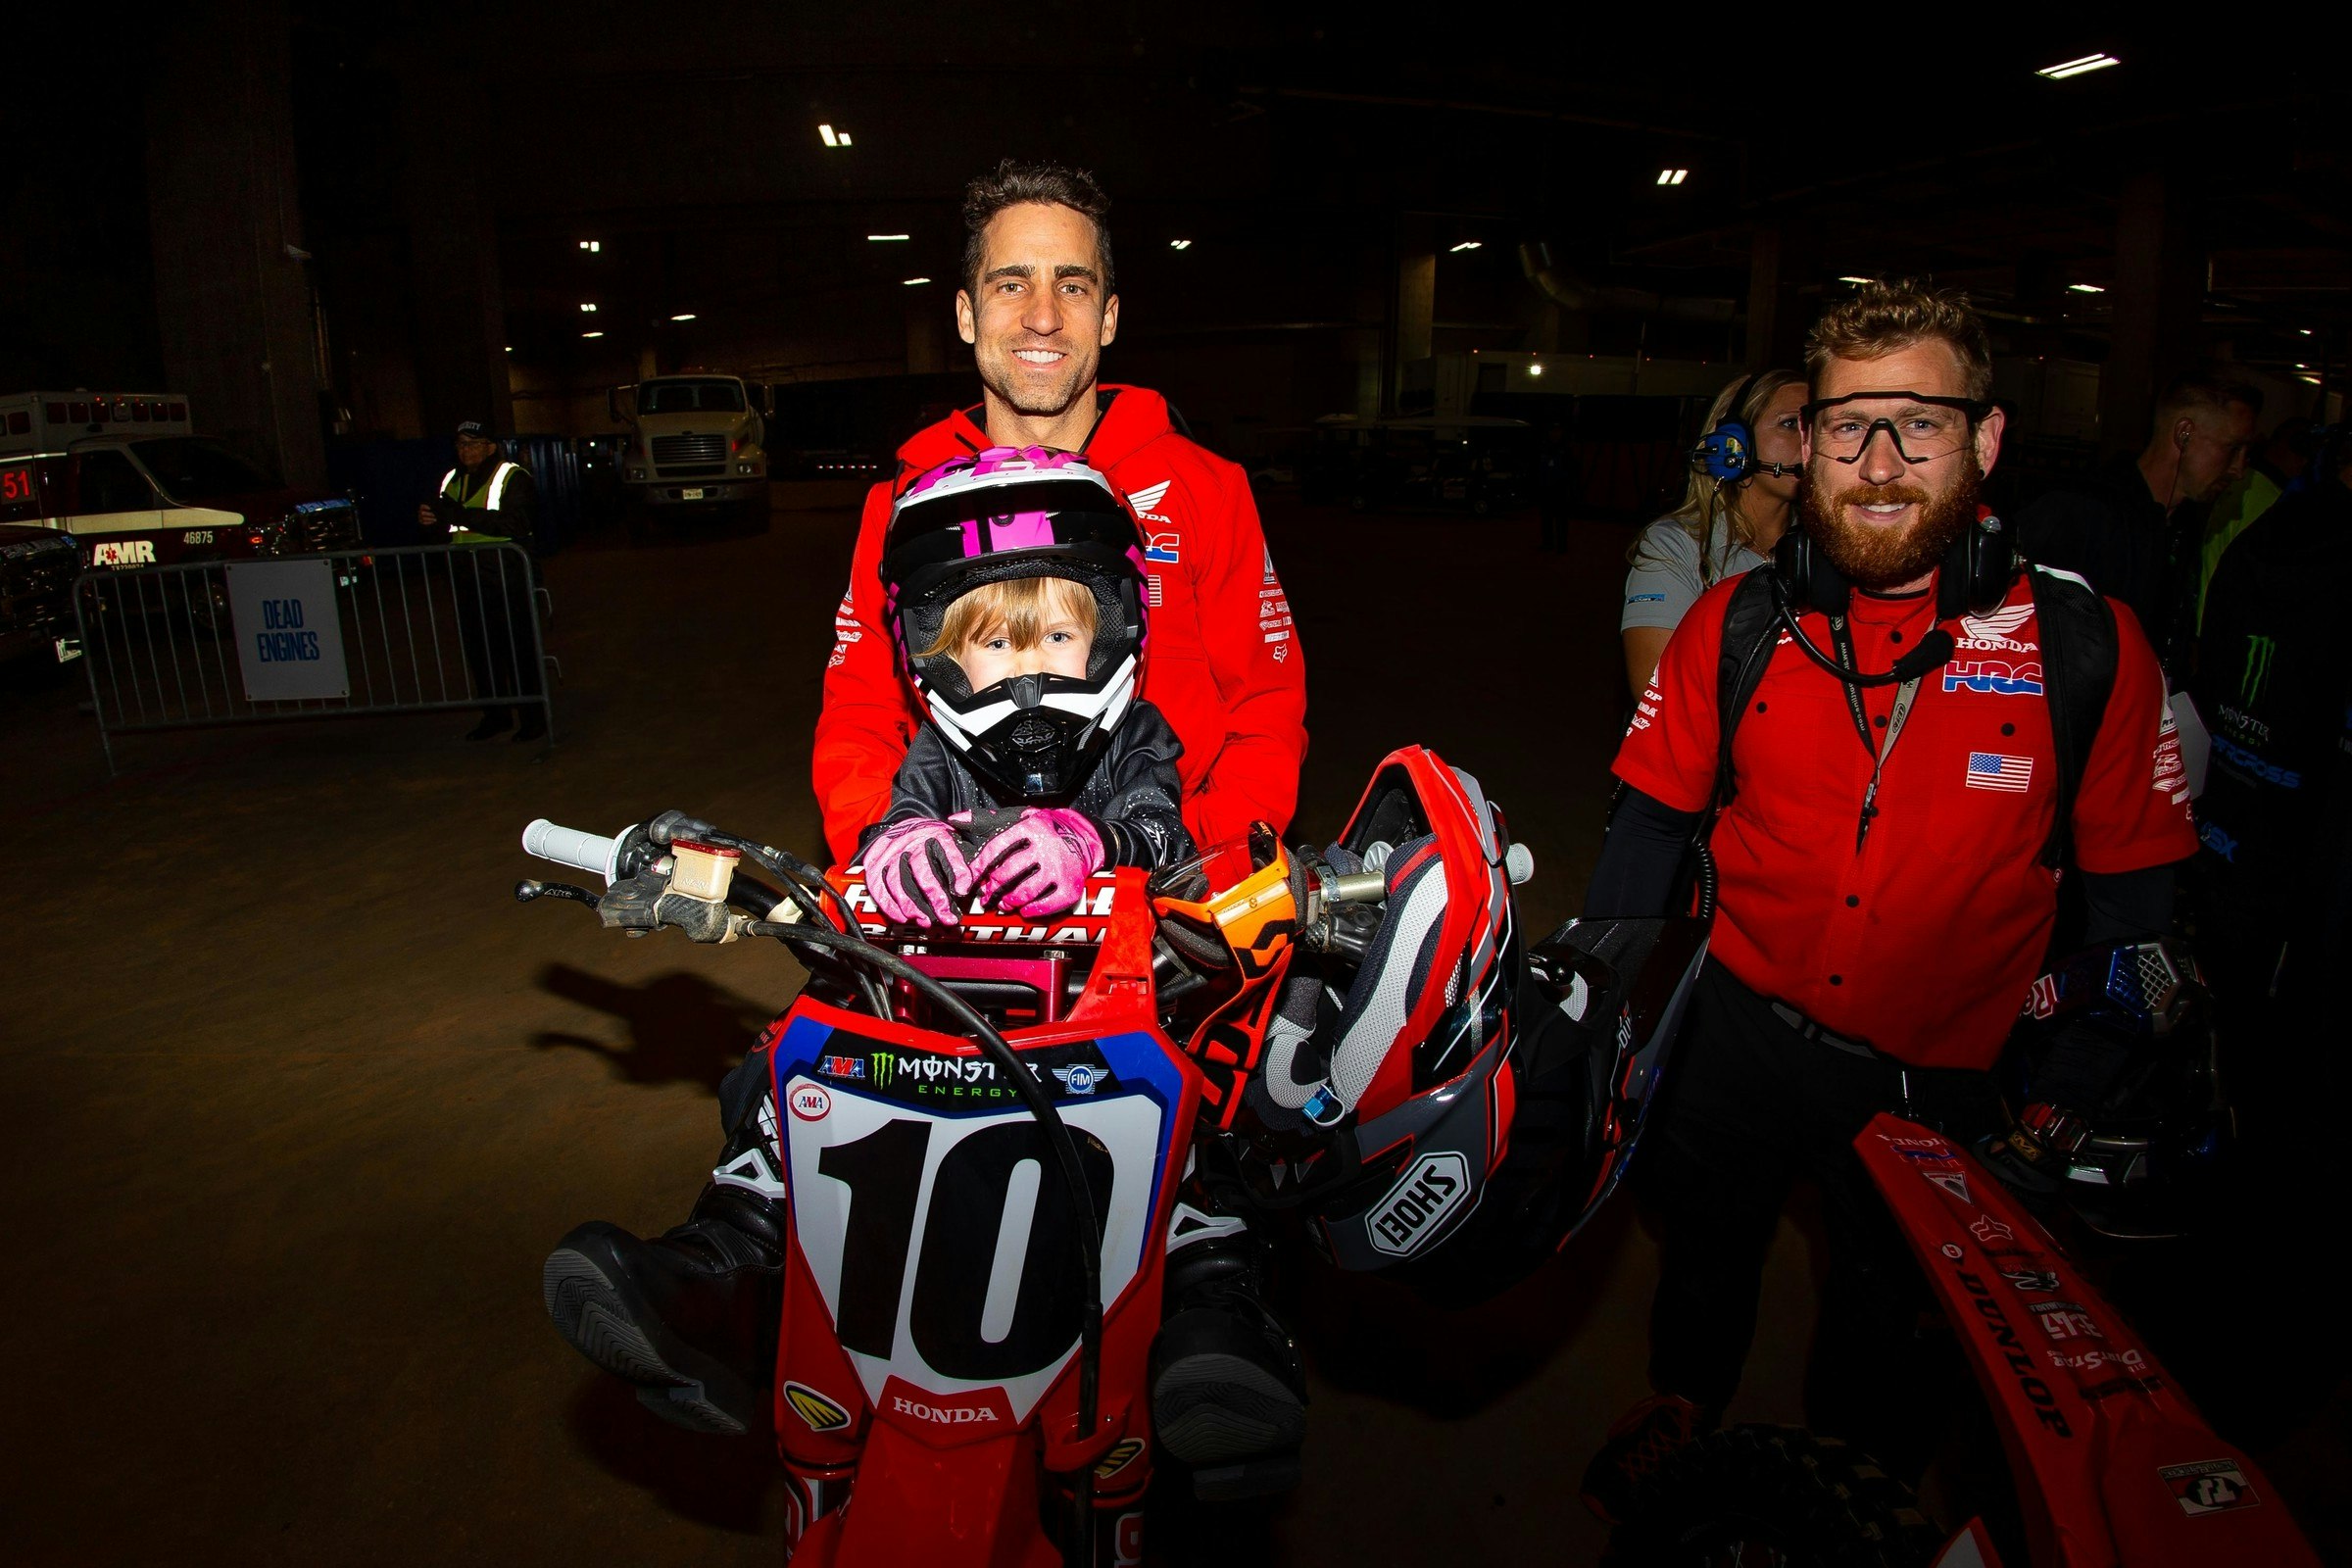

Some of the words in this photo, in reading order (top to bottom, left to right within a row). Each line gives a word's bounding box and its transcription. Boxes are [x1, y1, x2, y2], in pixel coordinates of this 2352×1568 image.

[3, 469, 30, 500] 51
[183, 531, 214, 545] 46875
[93, 540, 157, 567] AMR
[262, 598, 304, 630] DEAD
[257, 631, 320, 662] ENGINES
[1955, 637, 2039, 654] HONDA
[1942, 661, 2044, 696] HRC
[817, 1055, 865, 1080] AMA
[898, 1055, 1043, 1083] MONSTR
[1070, 1073, 1092, 1087] FIM
[799, 1096, 824, 1109] AMA
[917, 1085, 1018, 1098] ENERGY
[1374, 1163, 1457, 1248] SHOEI
[817, 1118, 1115, 1381] 10
[1956, 1271, 2075, 1439] DUNLOP
[893, 1396, 999, 1424] HONDA
